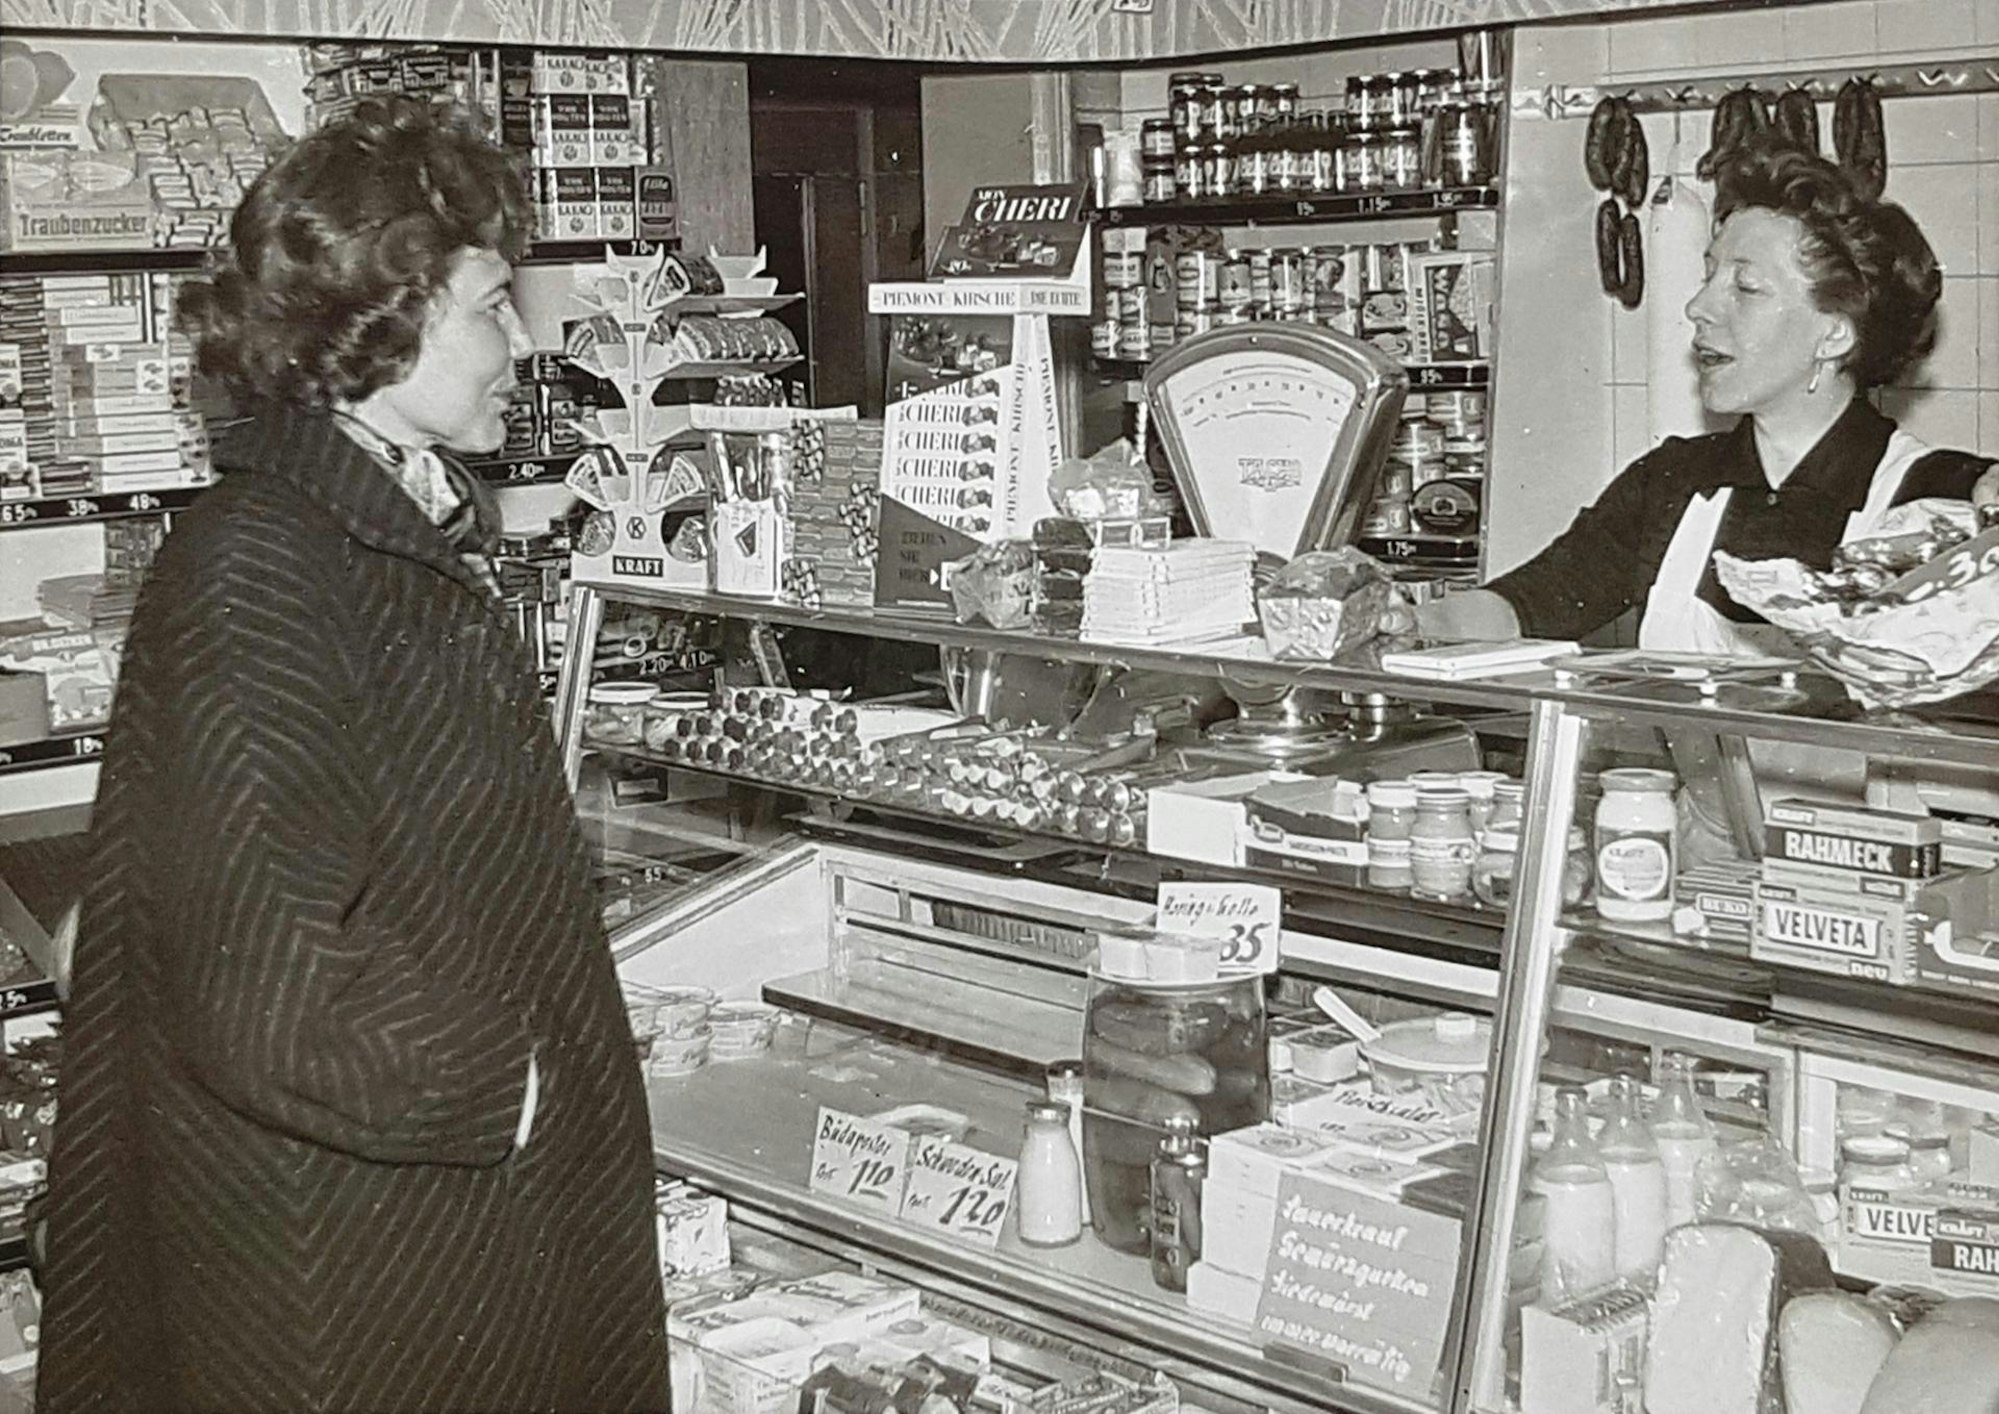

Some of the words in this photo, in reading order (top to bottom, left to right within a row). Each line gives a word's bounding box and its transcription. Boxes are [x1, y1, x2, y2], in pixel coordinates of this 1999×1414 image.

[975, 197, 1071, 222] CHERI
[19, 213, 147, 237] Traubenzucker
[883, 290, 943, 307] PIEMONT
[953, 291, 1015, 307] KIRSCHE
[906, 404, 960, 422] CHERI
[904, 432, 959, 450] CHERI
[902, 458, 957, 477] CHERI
[900, 486, 955, 505] CHERI
[615, 558, 661, 576] KRAFT
[1784, 830, 1894, 873] RAHMECK
[1775, 907, 1868, 950] VELVETA
[1867, 1208, 1933, 1237] VELVE
